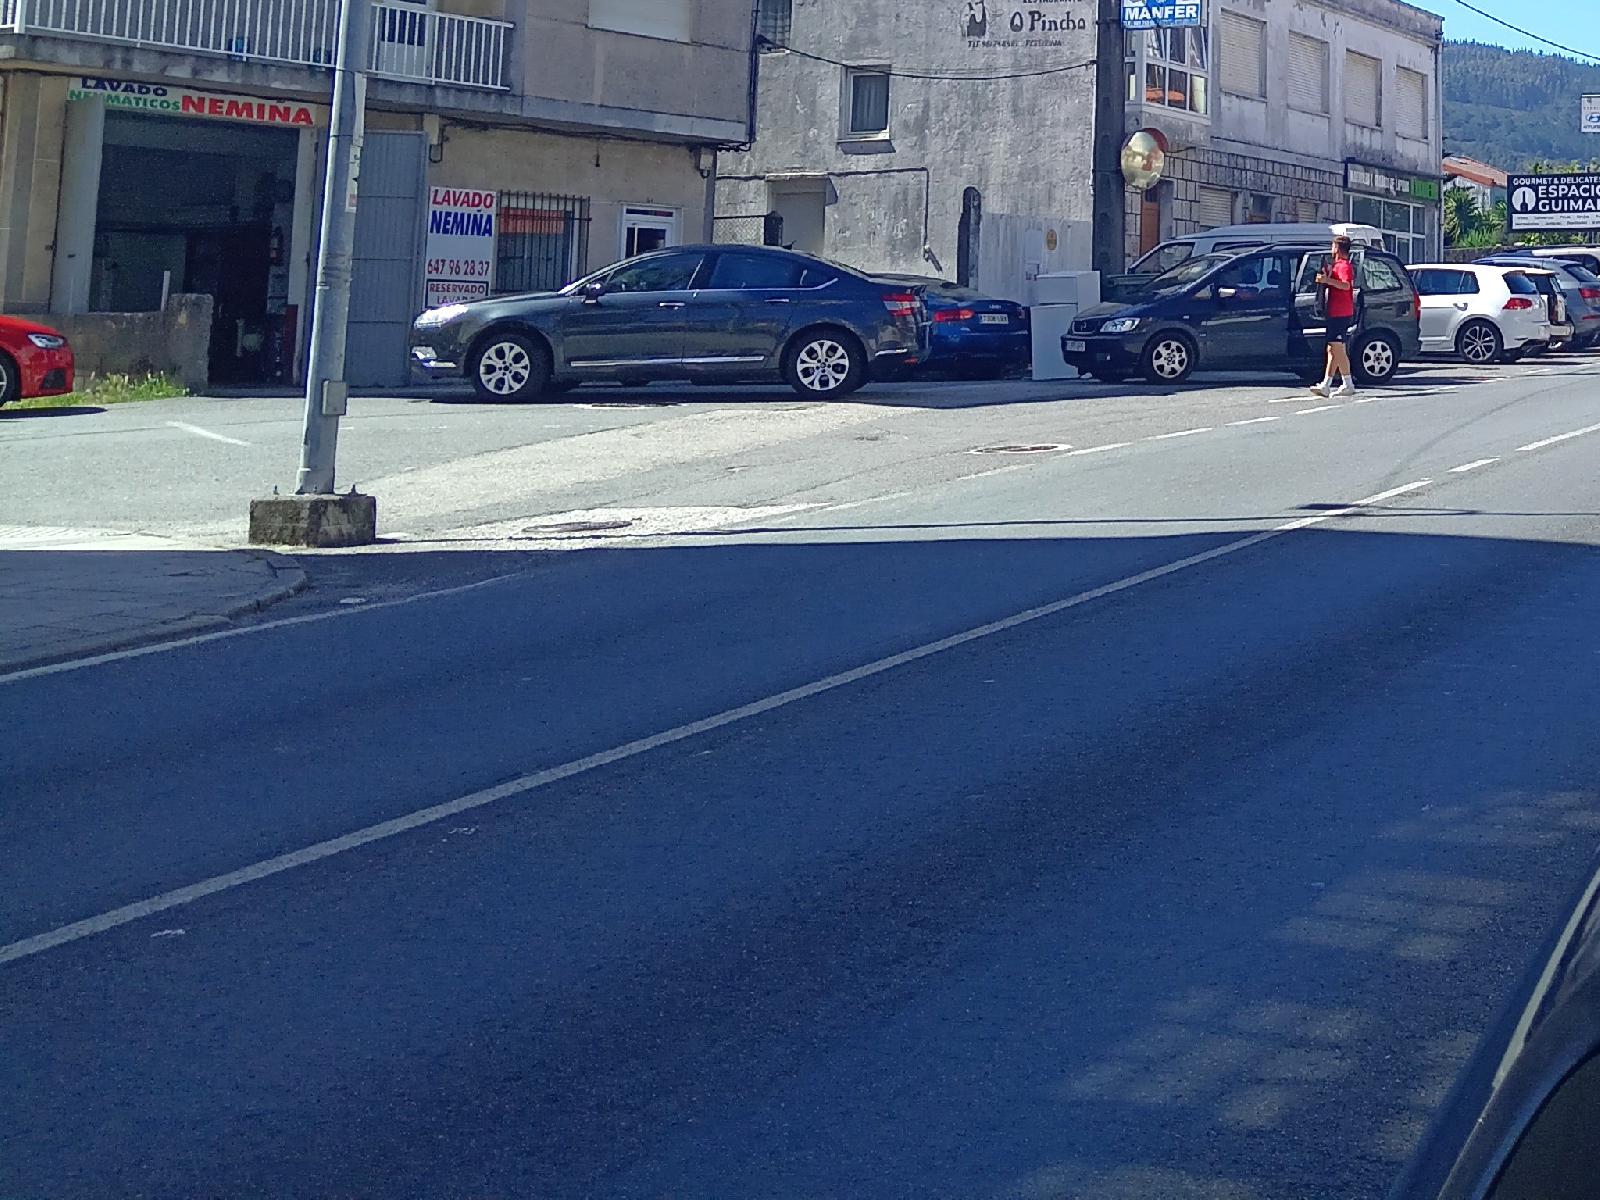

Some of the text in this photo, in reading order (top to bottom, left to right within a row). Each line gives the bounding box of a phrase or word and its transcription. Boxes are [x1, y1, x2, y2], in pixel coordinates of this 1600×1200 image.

[1009, 10, 1086, 32] O Pincho
[1124, 4, 1197, 21] MANFER
[81, 78, 168, 97] LAVADO
[1513, 177, 1552, 186] GOURMET
[432, 188, 494, 209] LAVADO
[429, 209, 493, 237] NEMIÑA
[427, 258, 490, 276] 647 96 28 37
[429, 283, 486, 295] RESERVADO
